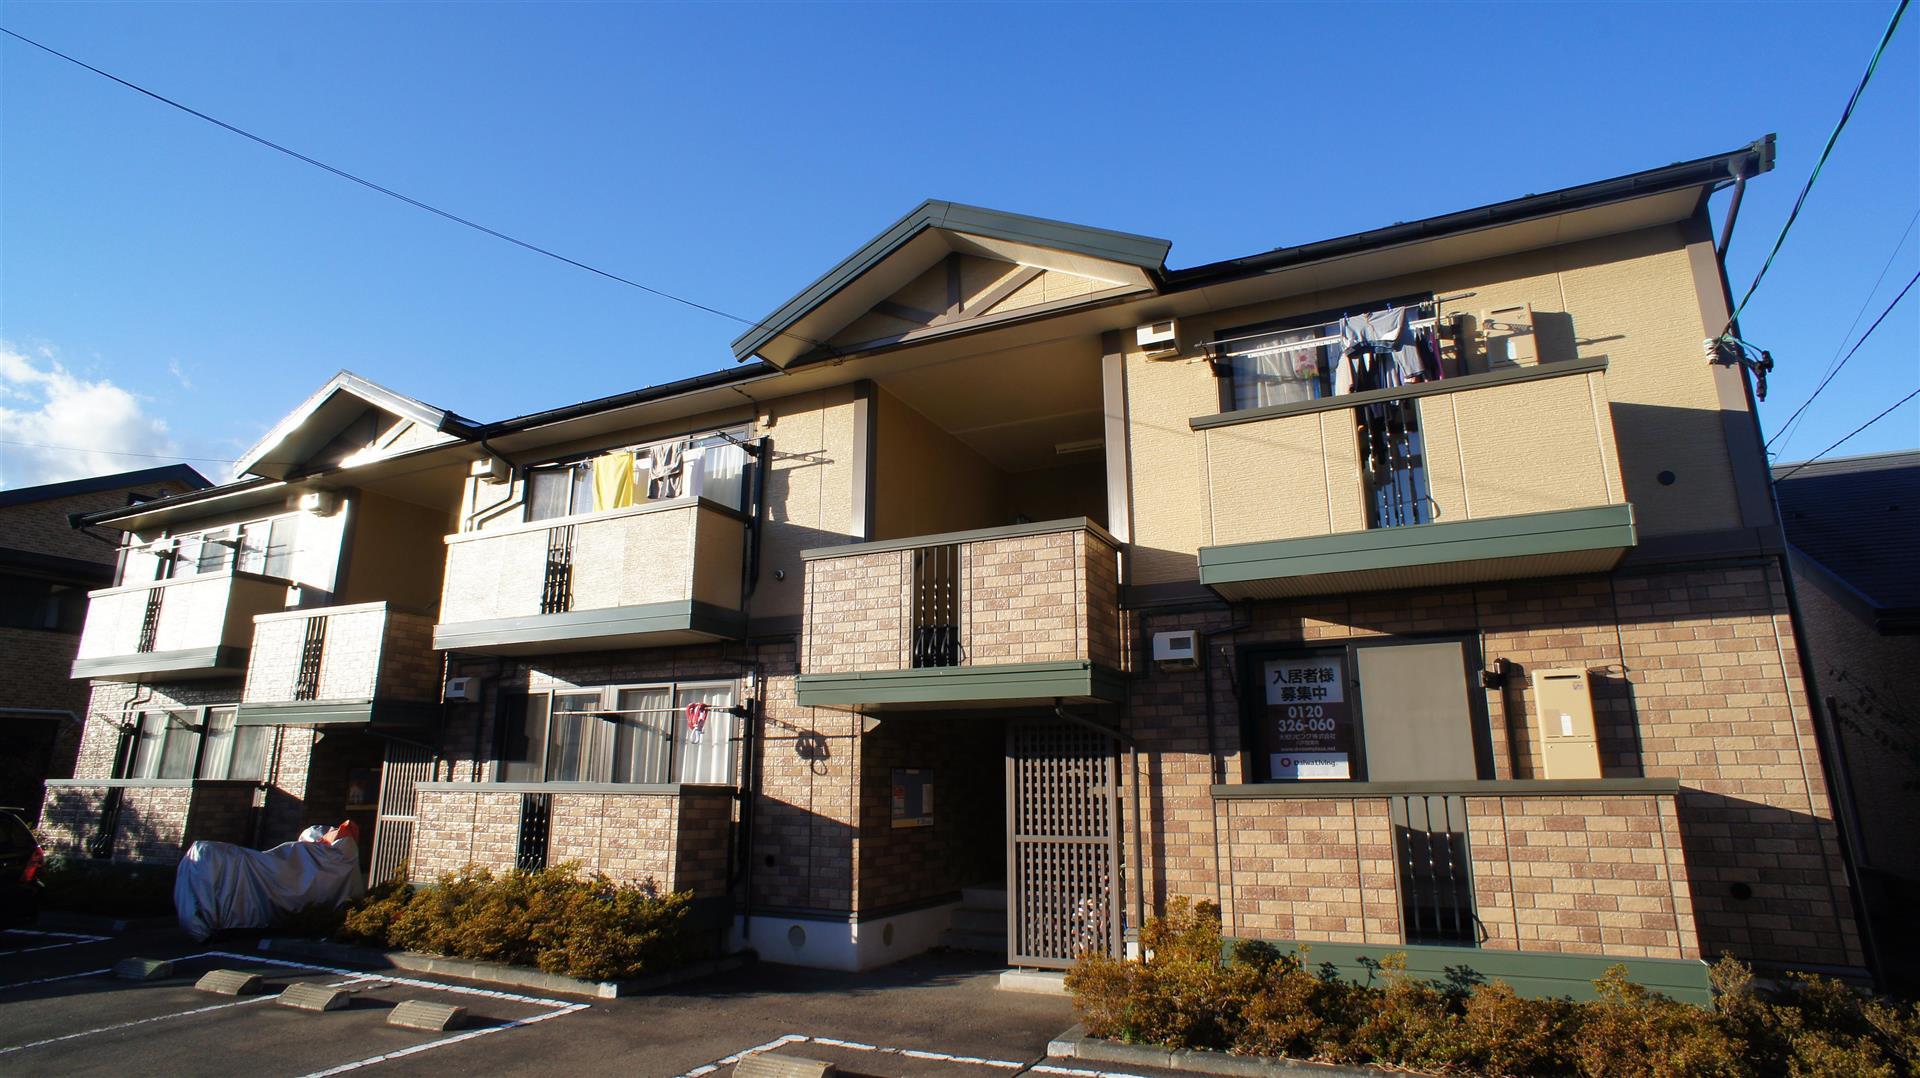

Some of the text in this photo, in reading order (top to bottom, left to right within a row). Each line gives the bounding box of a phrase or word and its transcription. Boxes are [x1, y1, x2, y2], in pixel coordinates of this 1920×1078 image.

[1272, 668, 1335, 684] 入居者様
[1280, 685, 1327, 702] 募集中
[1288, 705, 1324, 718] 0120
[1279, 718, 1336, 732] 326-060
